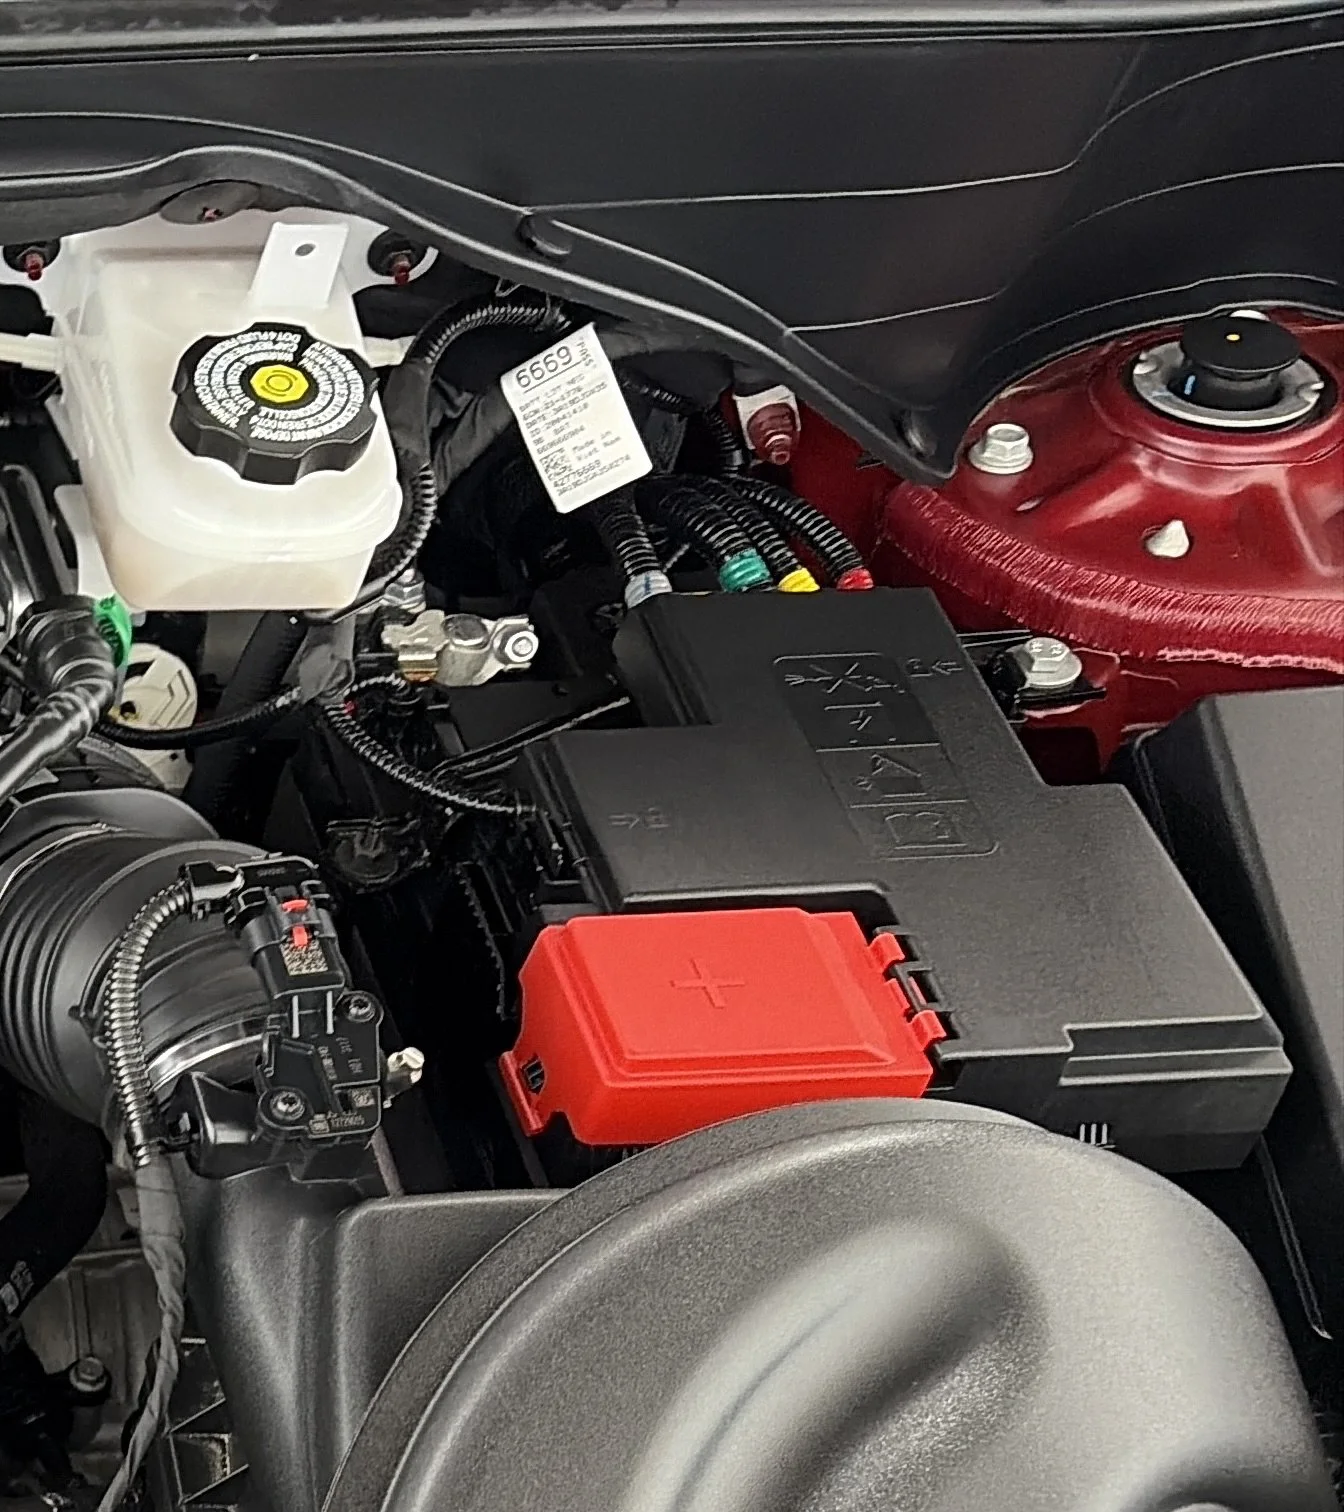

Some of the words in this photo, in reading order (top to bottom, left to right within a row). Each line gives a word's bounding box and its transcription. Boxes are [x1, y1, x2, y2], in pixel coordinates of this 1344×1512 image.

[276, 331, 301, 343] DOT
[515, 346, 572, 388] 6669
[220, 394, 249, 417] ONLY
